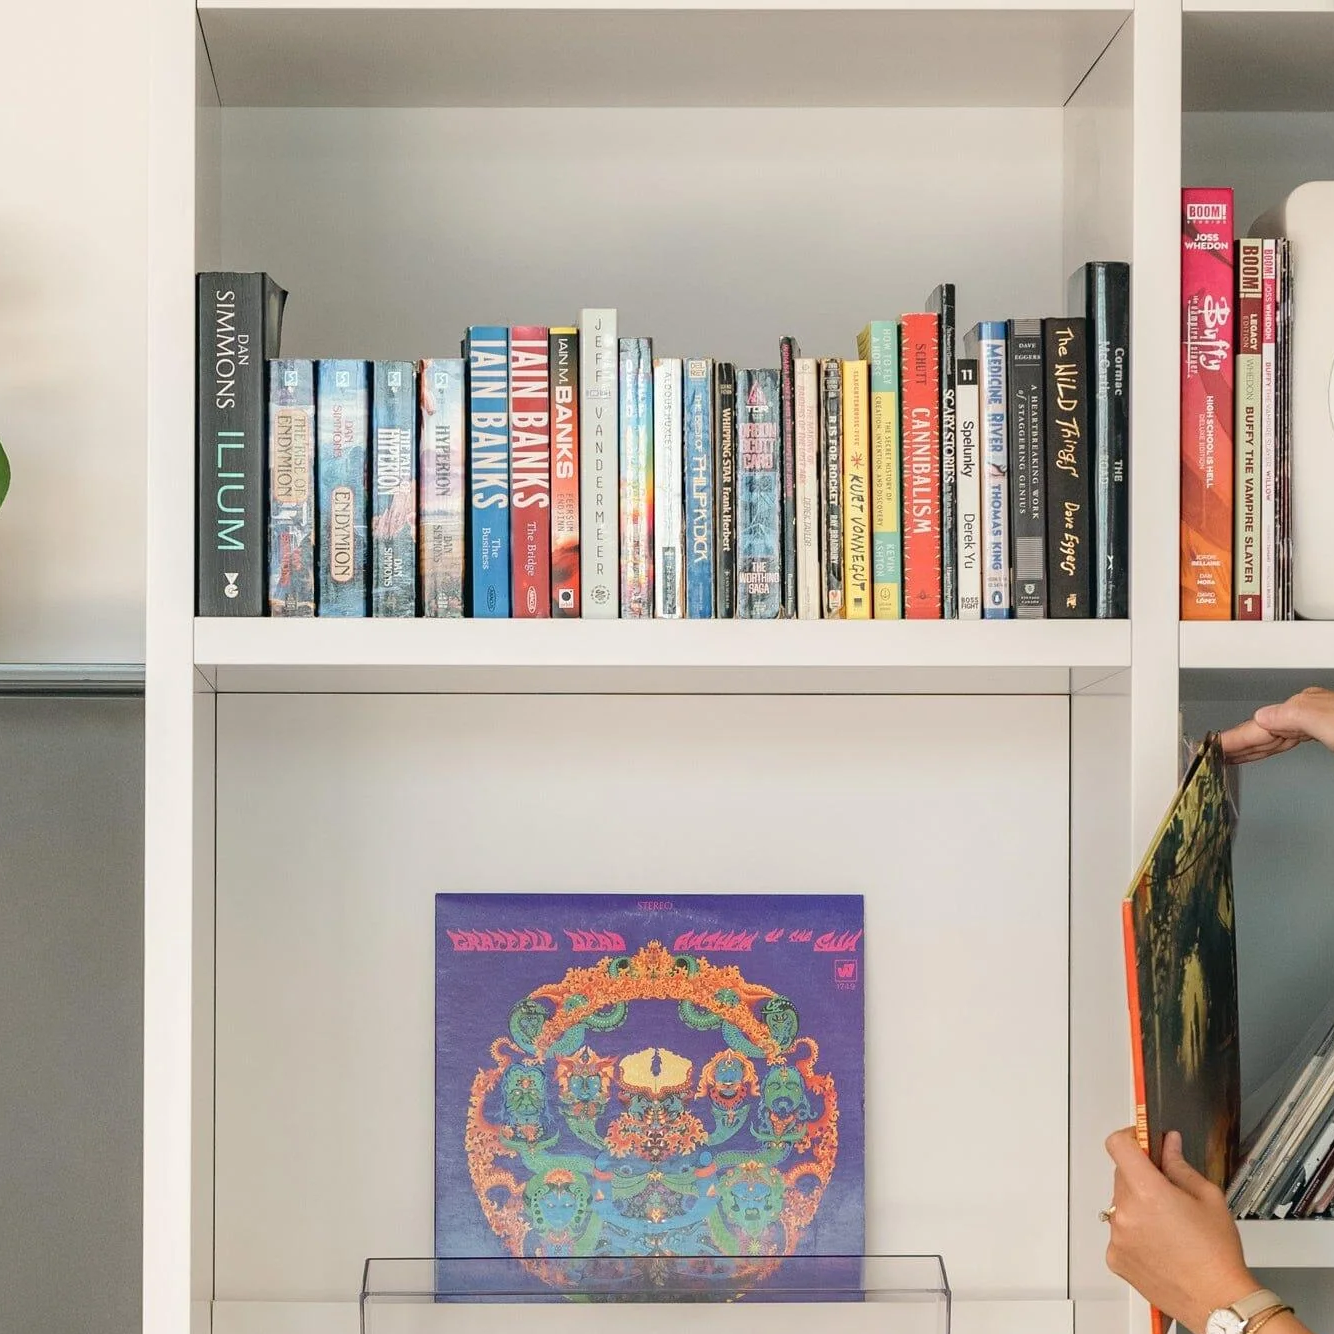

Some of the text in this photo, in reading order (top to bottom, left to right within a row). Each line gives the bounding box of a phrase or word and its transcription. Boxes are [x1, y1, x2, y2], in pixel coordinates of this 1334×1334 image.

[1185, 242, 1229, 250] WHEDON
[1194, 233, 1219, 241] JOSS
[216, 290, 236, 410] SIMMONS
[238, 334, 249, 365] DAN
[1055, 328, 1074, 357] The
[1197, 294, 1231, 372] Buffy
[916, 343, 927, 386] SCHUTT
[1114, 347, 1125, 396] Cormac
[555, 338, 574, 479] IAIN M. BANKS
[943, 388, 955, 430] SCARY
[1016, 390, 1027, 401] of
[471, 340, 509, 509] IAIN BANKS
[512, 340, 550, 509] IAIN BANKS
[594, 318, 605, 575] JEFF VANDERMEER
[829, 440, 838, 461] FOR
[1031, 396, 1039, 484] HEARTBREAKING
[1055, 417, 1079, 478] Things
[436, 425, 451, 497] HYPERION
[722, 408, 731, 552] WHIPPING STAR Frank Herbert
[829, 464, 838, 505] ROCKET
[911, 407, 931, 535] CANNIBALISM
[943, 431, 955, 483] STORIES
[986, 344, 1004, 570] MEDICINE RIVER THOMAS KING
[218, 431, 245, 551] ILIUM
[961, 420, 976, 570] Spelunky Derek Yu
[1032, 491, 1040, 520] WORK
[1065, 501, 1080, 530] Dave
[1244, 407, 1255, 584] BUFFY THE VAMPIRE SLAYER
[335, 491, 352, 577] ENDYMION
[482, 527, 492, 570] Business
[492, 539, 501, 560] The
[526, 522, 537, 577] The Bridge
[850, 473, 866, 591] KURT VONNEGUT
[1060, 532, 1079, 577] Eggers
[1244, 598, 1252, 612] 1
